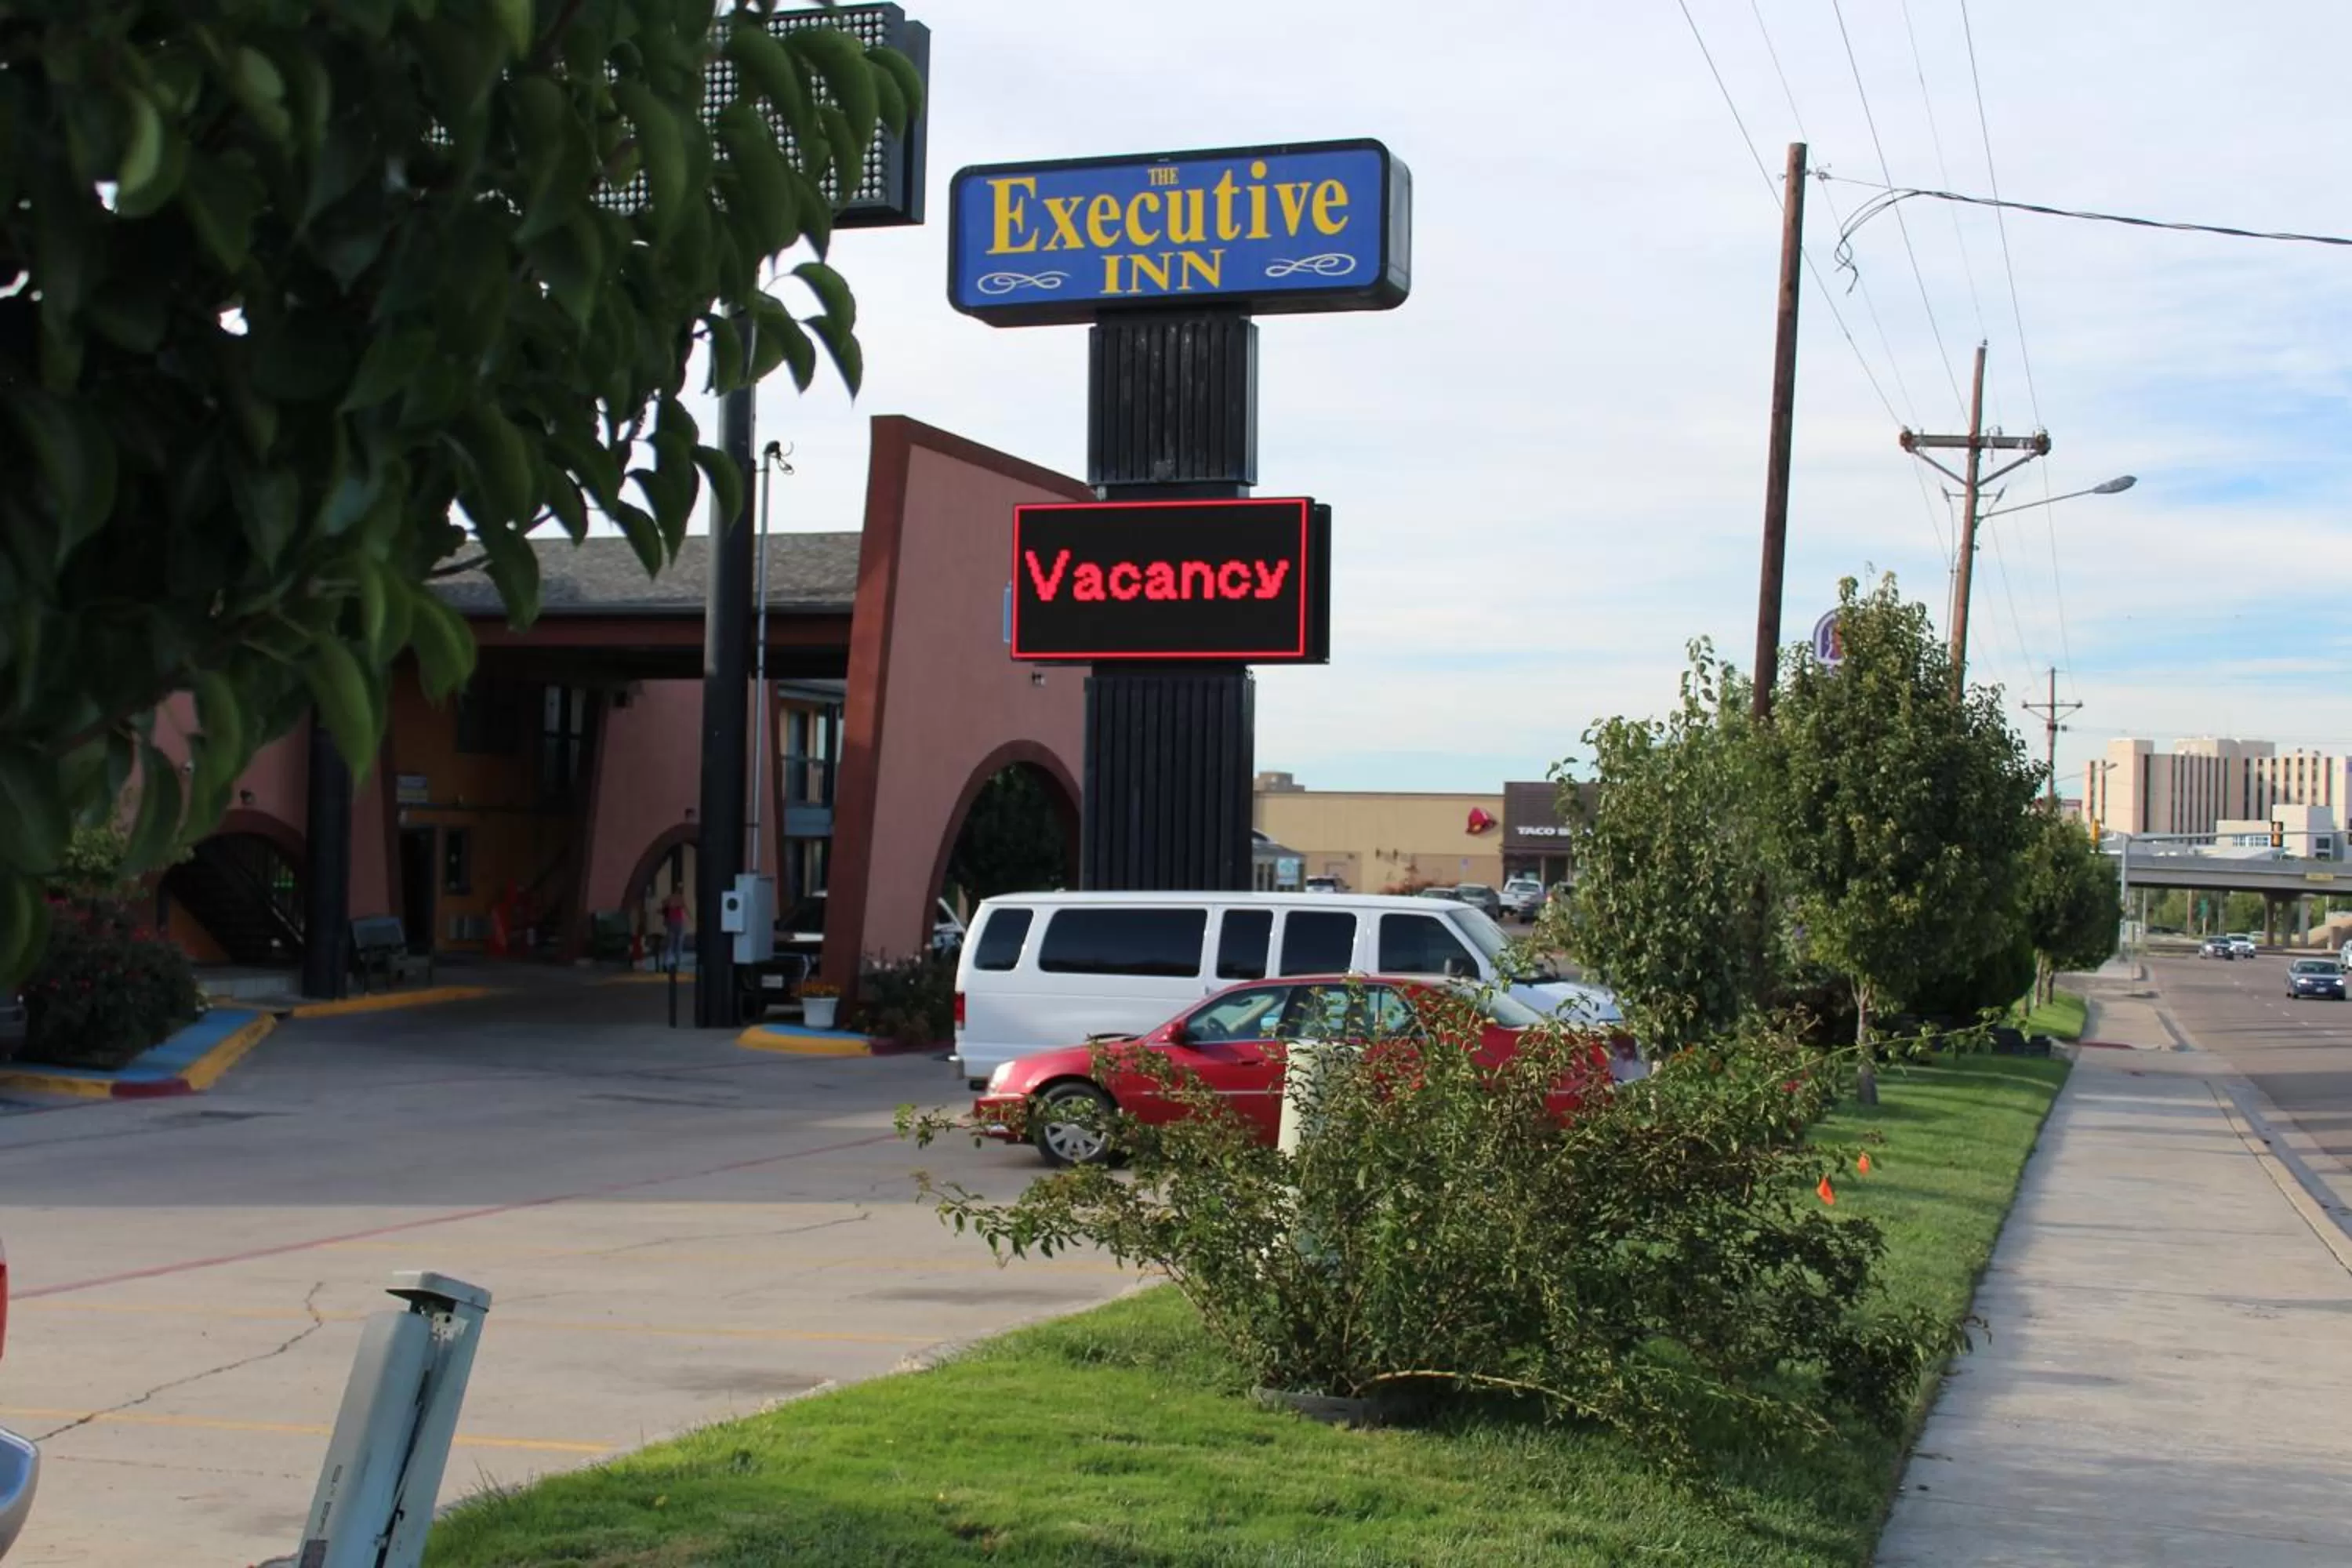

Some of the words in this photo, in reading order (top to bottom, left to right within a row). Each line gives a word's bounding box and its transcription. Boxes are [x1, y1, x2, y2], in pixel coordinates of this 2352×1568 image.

[1147, 167, 1179, 186] THE
[986, 161, 1349, 255] Executive
[1099, 249, 1226, 294] INN
[1025, 549, 1290, 601] Vacancy
[1516, 826, 1556, 836] TACO
